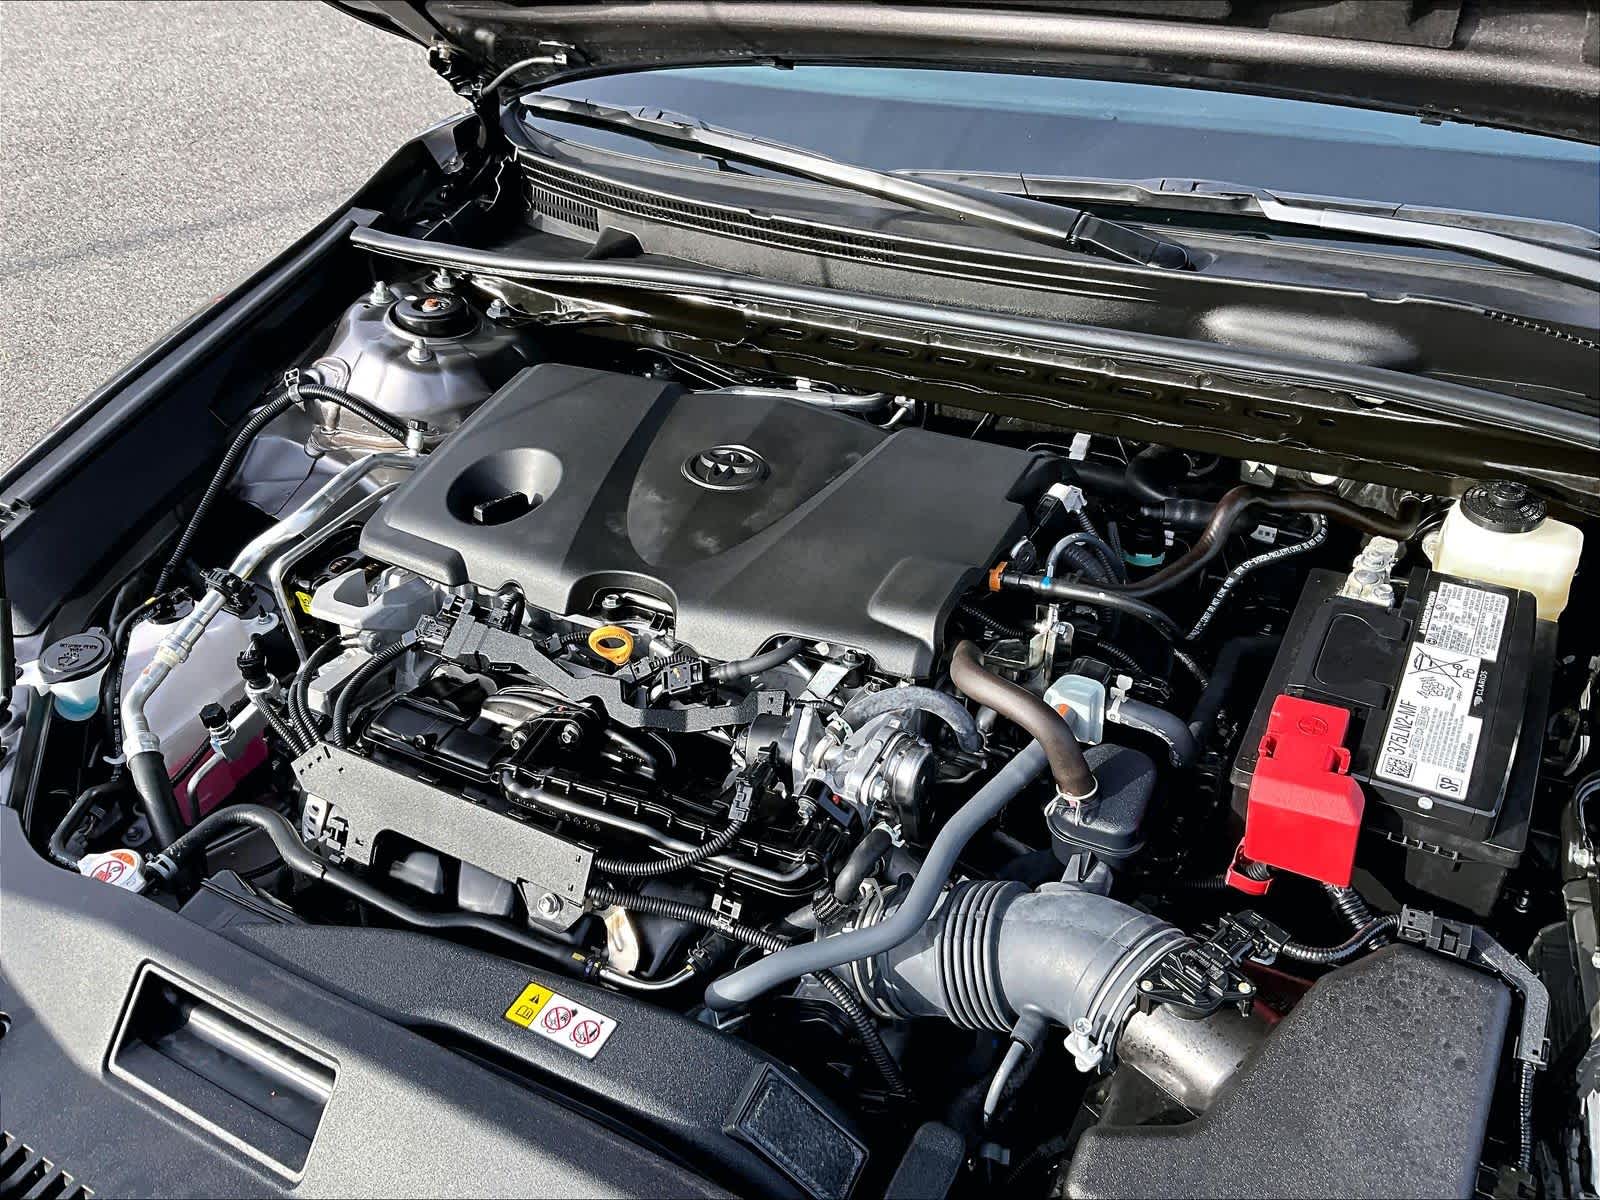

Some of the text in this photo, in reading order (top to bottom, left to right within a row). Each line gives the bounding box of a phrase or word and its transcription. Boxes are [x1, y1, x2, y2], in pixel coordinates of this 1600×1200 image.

[1462, 668, 1476, 680] Pb
[1475, 670, 1488, 697] CLARIOS
[1386, 698, 1418, 756] 375LN2-MF
[1439, 776, 1460, 793] SP
